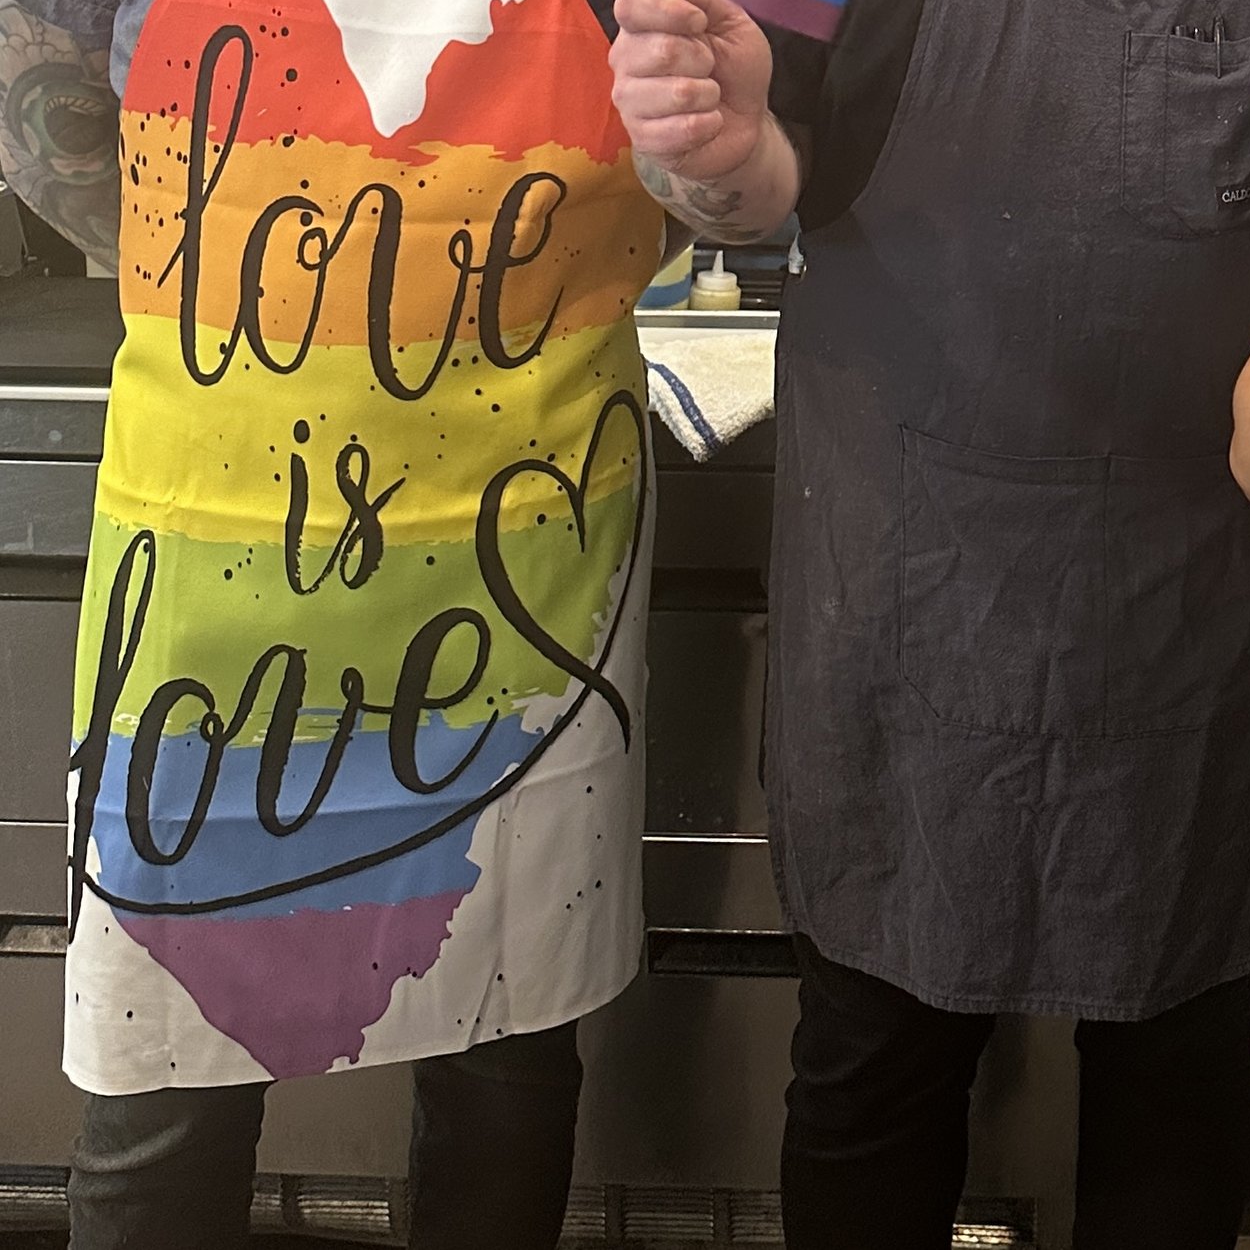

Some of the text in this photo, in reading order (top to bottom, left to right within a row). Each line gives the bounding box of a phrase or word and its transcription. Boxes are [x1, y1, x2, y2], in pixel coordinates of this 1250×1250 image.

[159, 25, 567, 402] love
[286, 419, 405, 596] is
[67, 529, 506, 943] love
